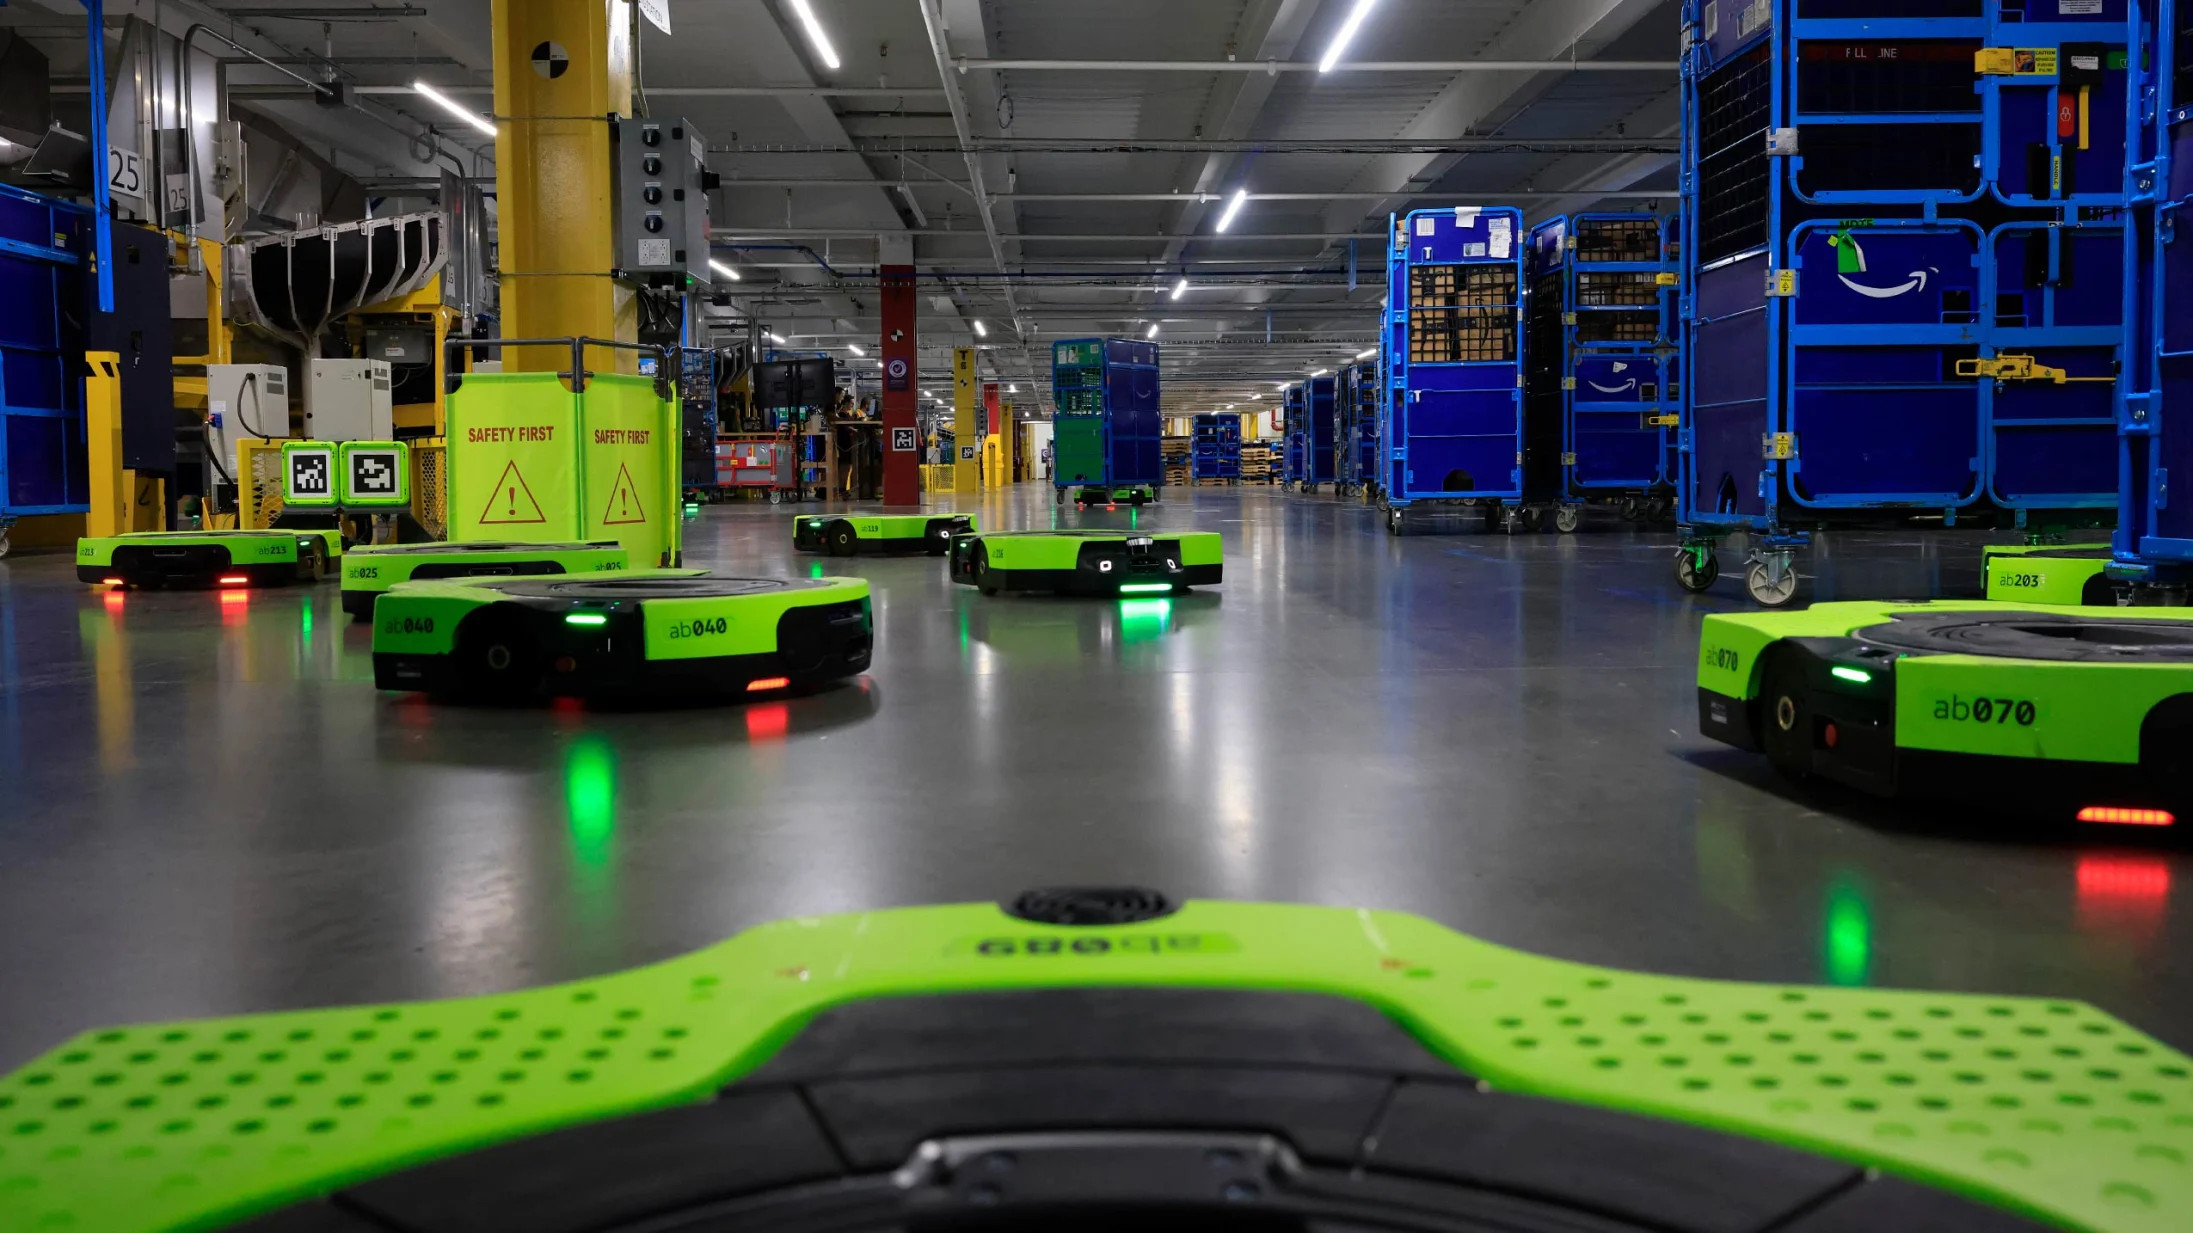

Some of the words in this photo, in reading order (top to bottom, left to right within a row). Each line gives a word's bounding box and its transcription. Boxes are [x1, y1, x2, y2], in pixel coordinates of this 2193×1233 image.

[1845, 47, 1867, 58] FLL
[110, 149, 139, 192] 25
[170, 187, 188, 211] 25
[959, 350, 968, 360] T
[468, 427, 515, 443] SAFETY
[519, 426, 554, 442] FIRST
[594, 429, 625, 444] SAFETY
[627, 430, 650, 444] FIRST
[258, 545, 287, 556] ab213
[349, 567, 378, 579] ab025
[1999, 573, 2039, 588] ab203
[384, 617, 434, 635] ab040
[669, 617, 727, 639] ab040
[1705, 645, 1738, 672] ab070
[1933, 693, 2036, 726] ab070
